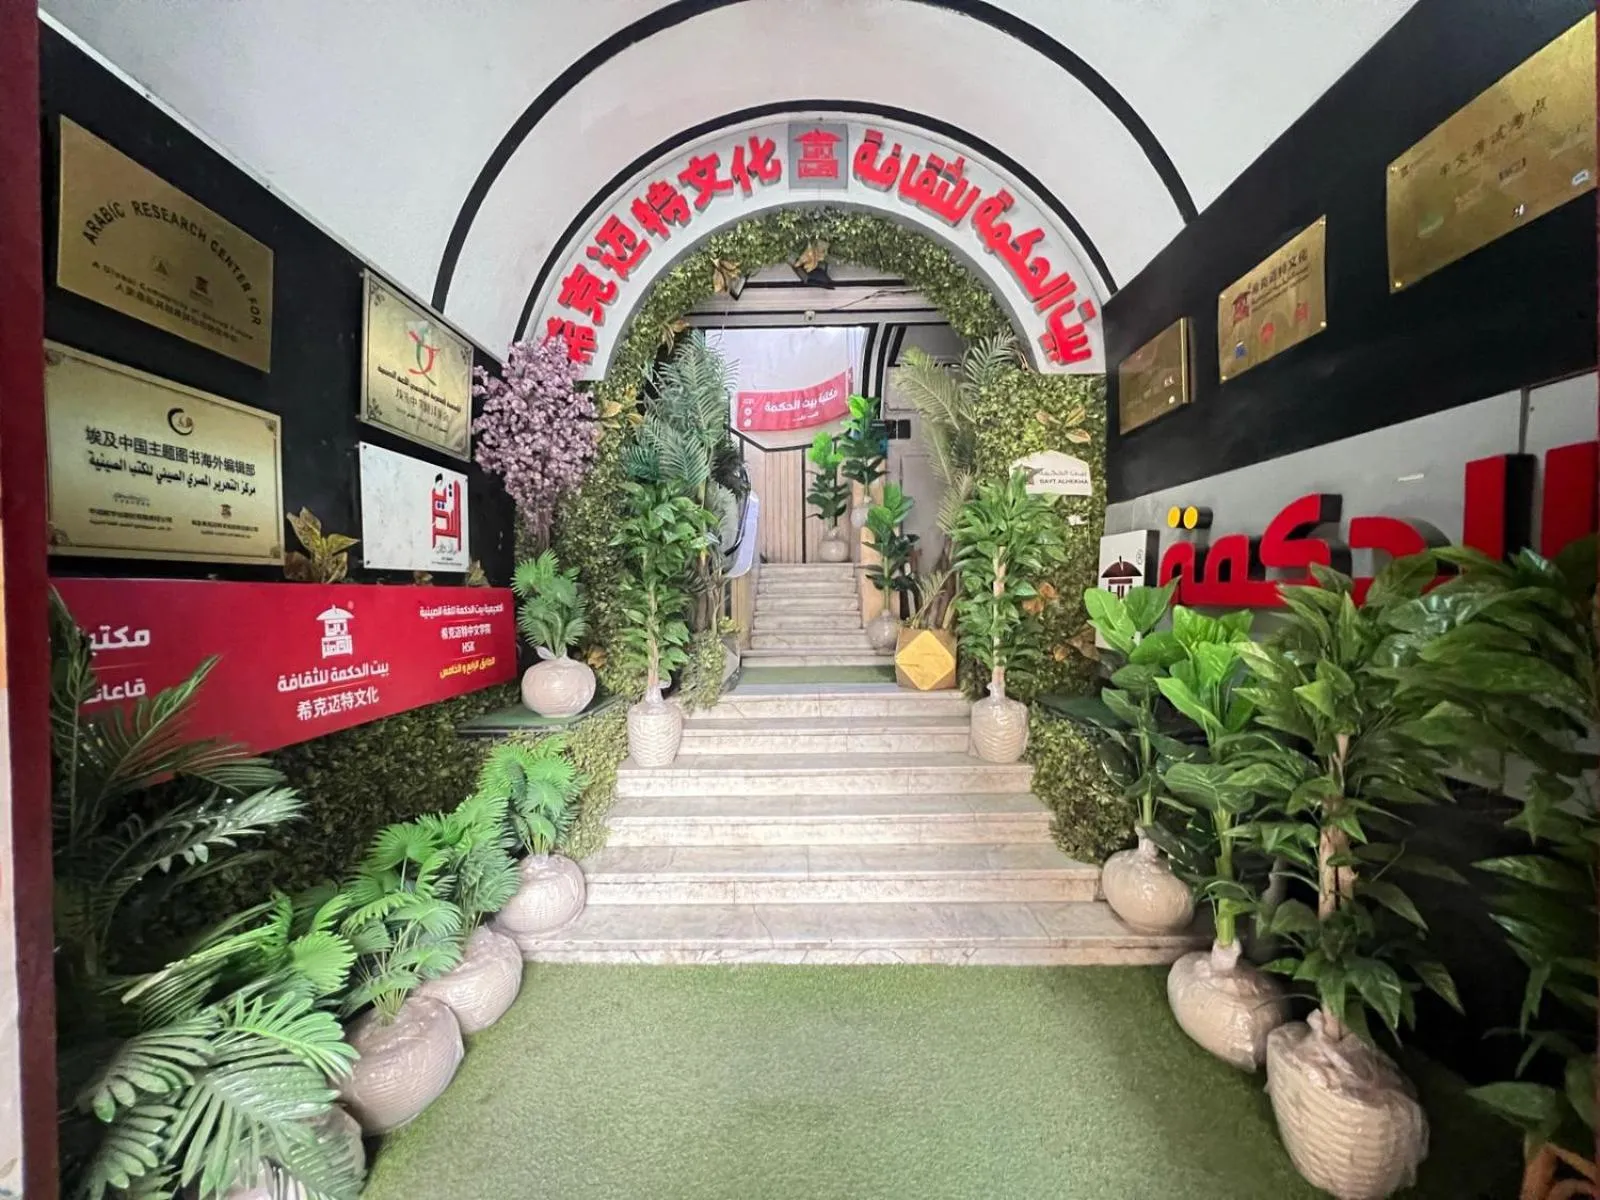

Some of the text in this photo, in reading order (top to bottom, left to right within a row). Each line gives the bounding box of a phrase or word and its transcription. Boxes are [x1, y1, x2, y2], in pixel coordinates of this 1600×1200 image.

[82, 201, 125, 246] ARABIC
[131, 199, 207, 243] RESEARCH
[209, 239, 252, 293] CENTER
[249, 296, 262, 327] FOR
[852, 128, 1098, 366] بيت الحكمة للثقافة
[764, 400, 801, 413] الحكمة
[85, 425, 256, 478] 埃及中国主题图书海外编辑部
[87, 450, 256, 497] مركز التحرير المصري الصيني للكتب الصينية
[89, 625, 151, 656] مكتب
[462, 641, 476, 654] HSK
[277, 661, 389, 692] بيت الحكمة للثقافة
[296, 686, 380, 722] 希克迈特文化
